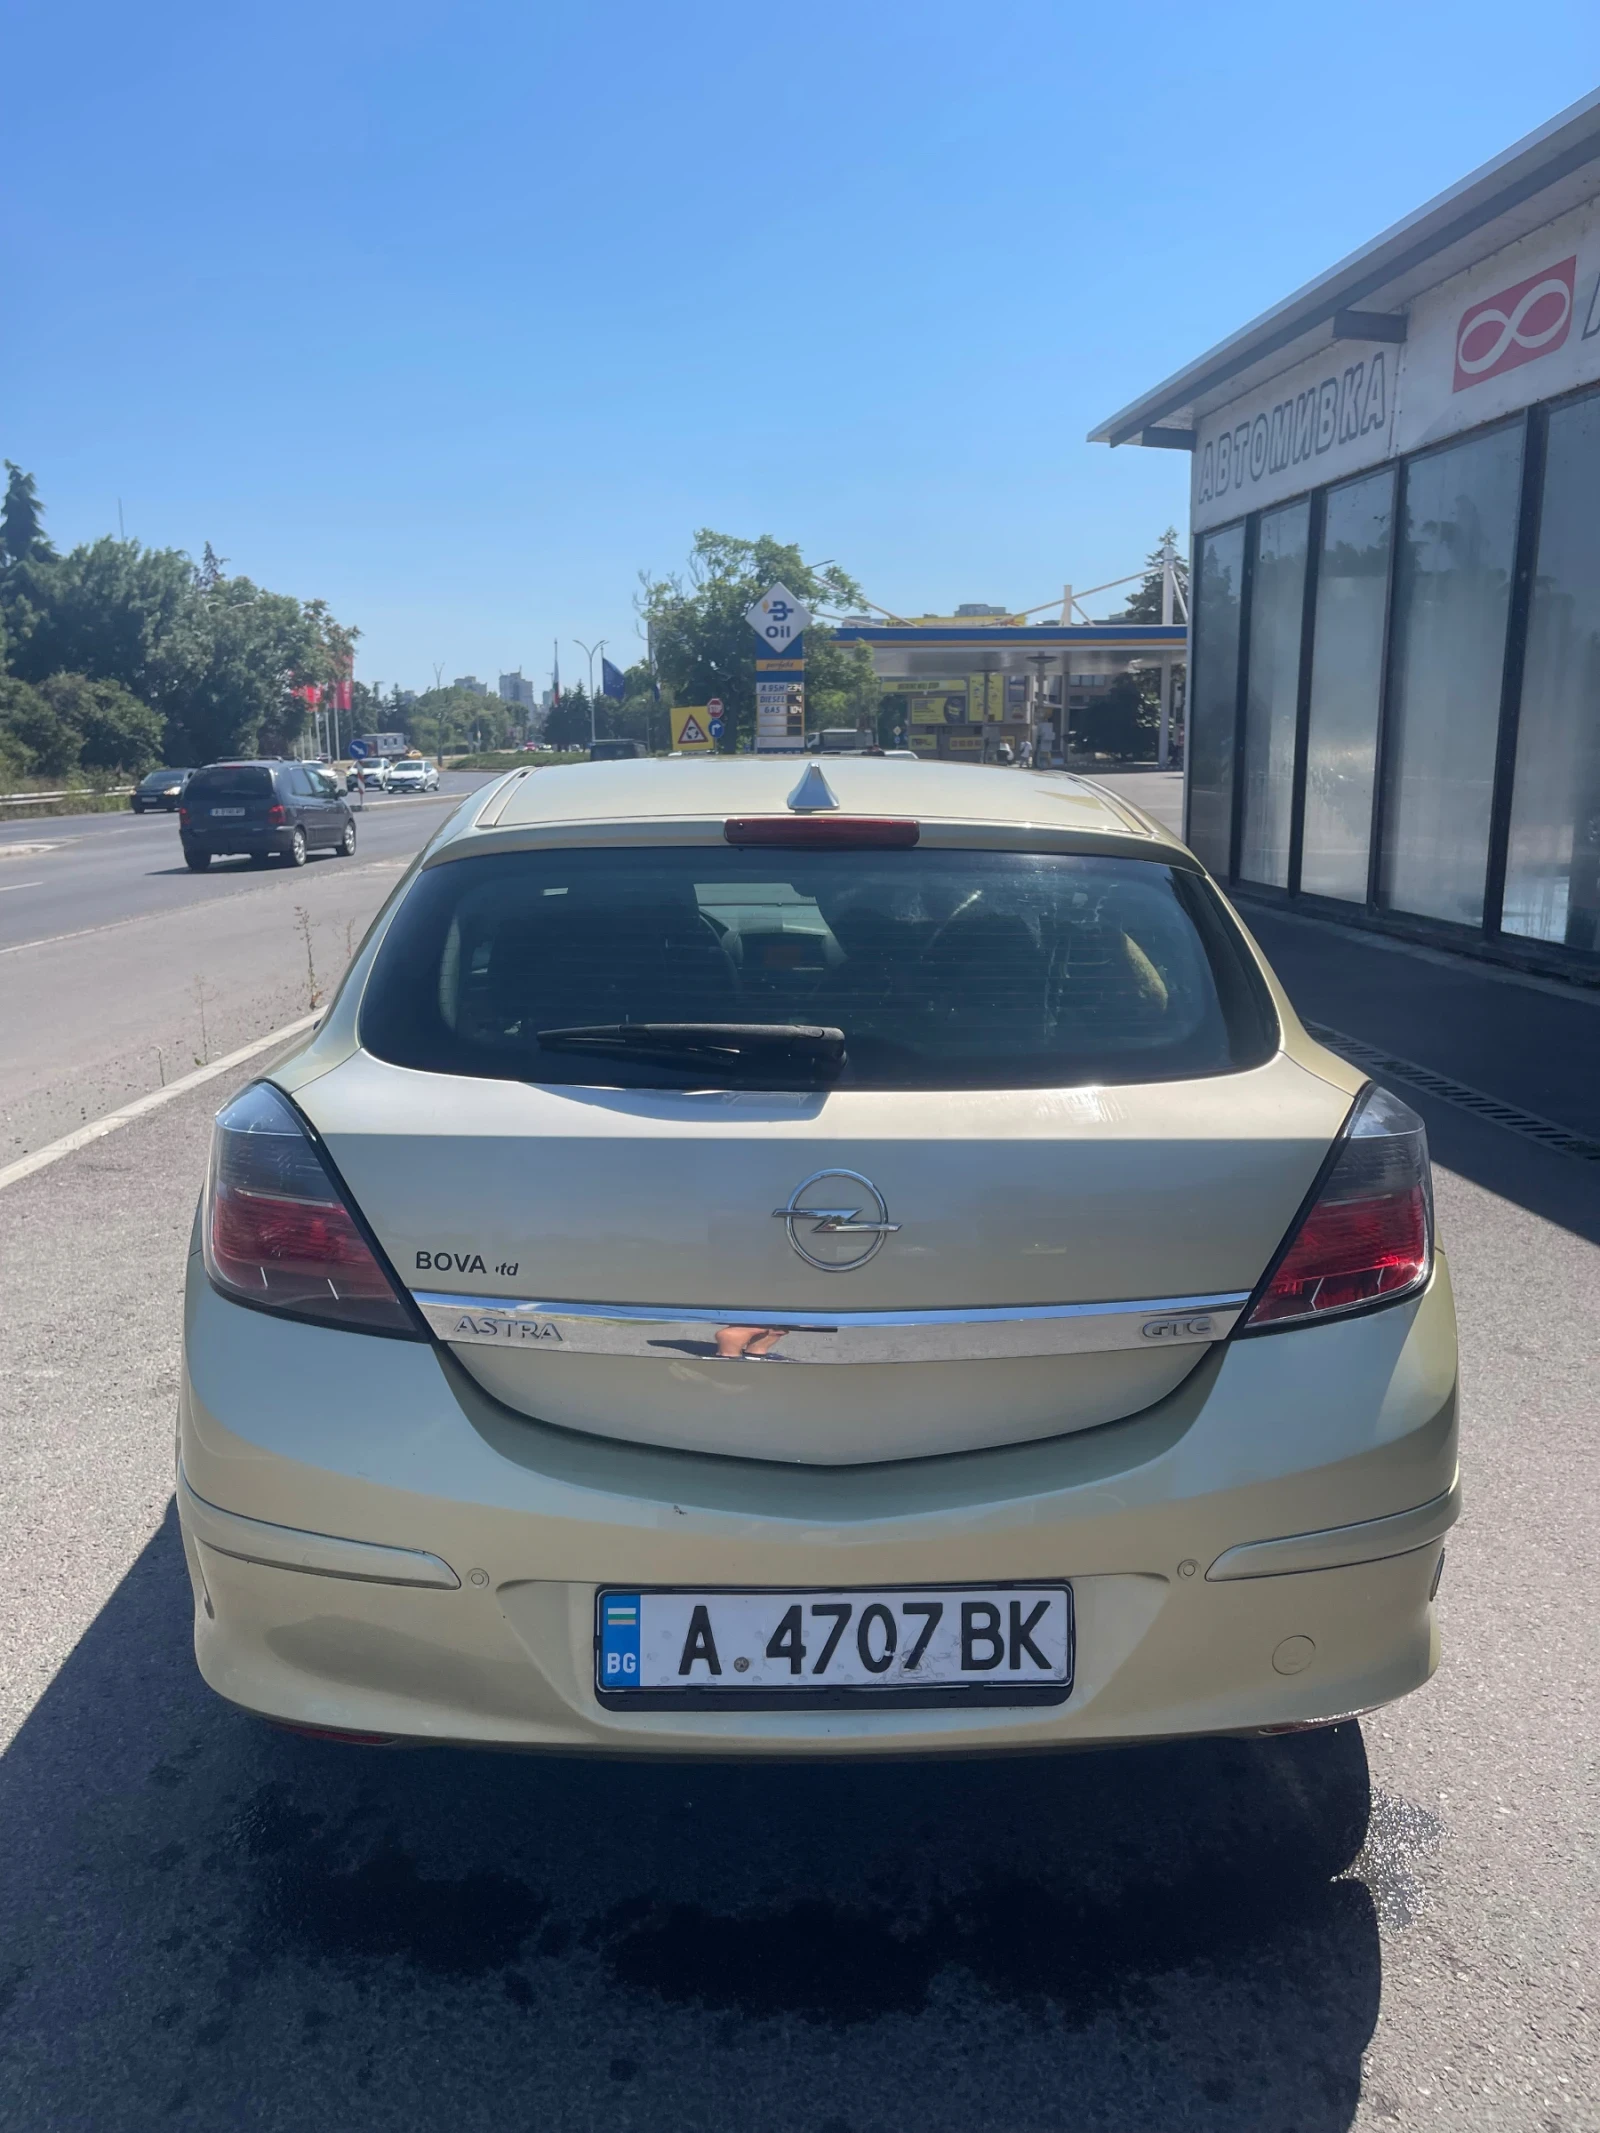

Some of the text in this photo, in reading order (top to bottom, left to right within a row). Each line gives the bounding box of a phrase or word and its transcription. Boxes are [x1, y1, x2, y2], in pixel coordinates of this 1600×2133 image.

[1198, 351, 1387, 504] АВТОМИВКА
[765, 626, 791, 638] Oil
[760, 695, 785, 703] DIESEL
[416, 1251, 487, 1274] BOVA
[453, 1315, 563, 1342] ASTRA
[1143, 1317, 1212, 1338] GTC
[678, 1600, 1053, 1676] A 4707 BK
[607, 1652, 637, 1674] BG
